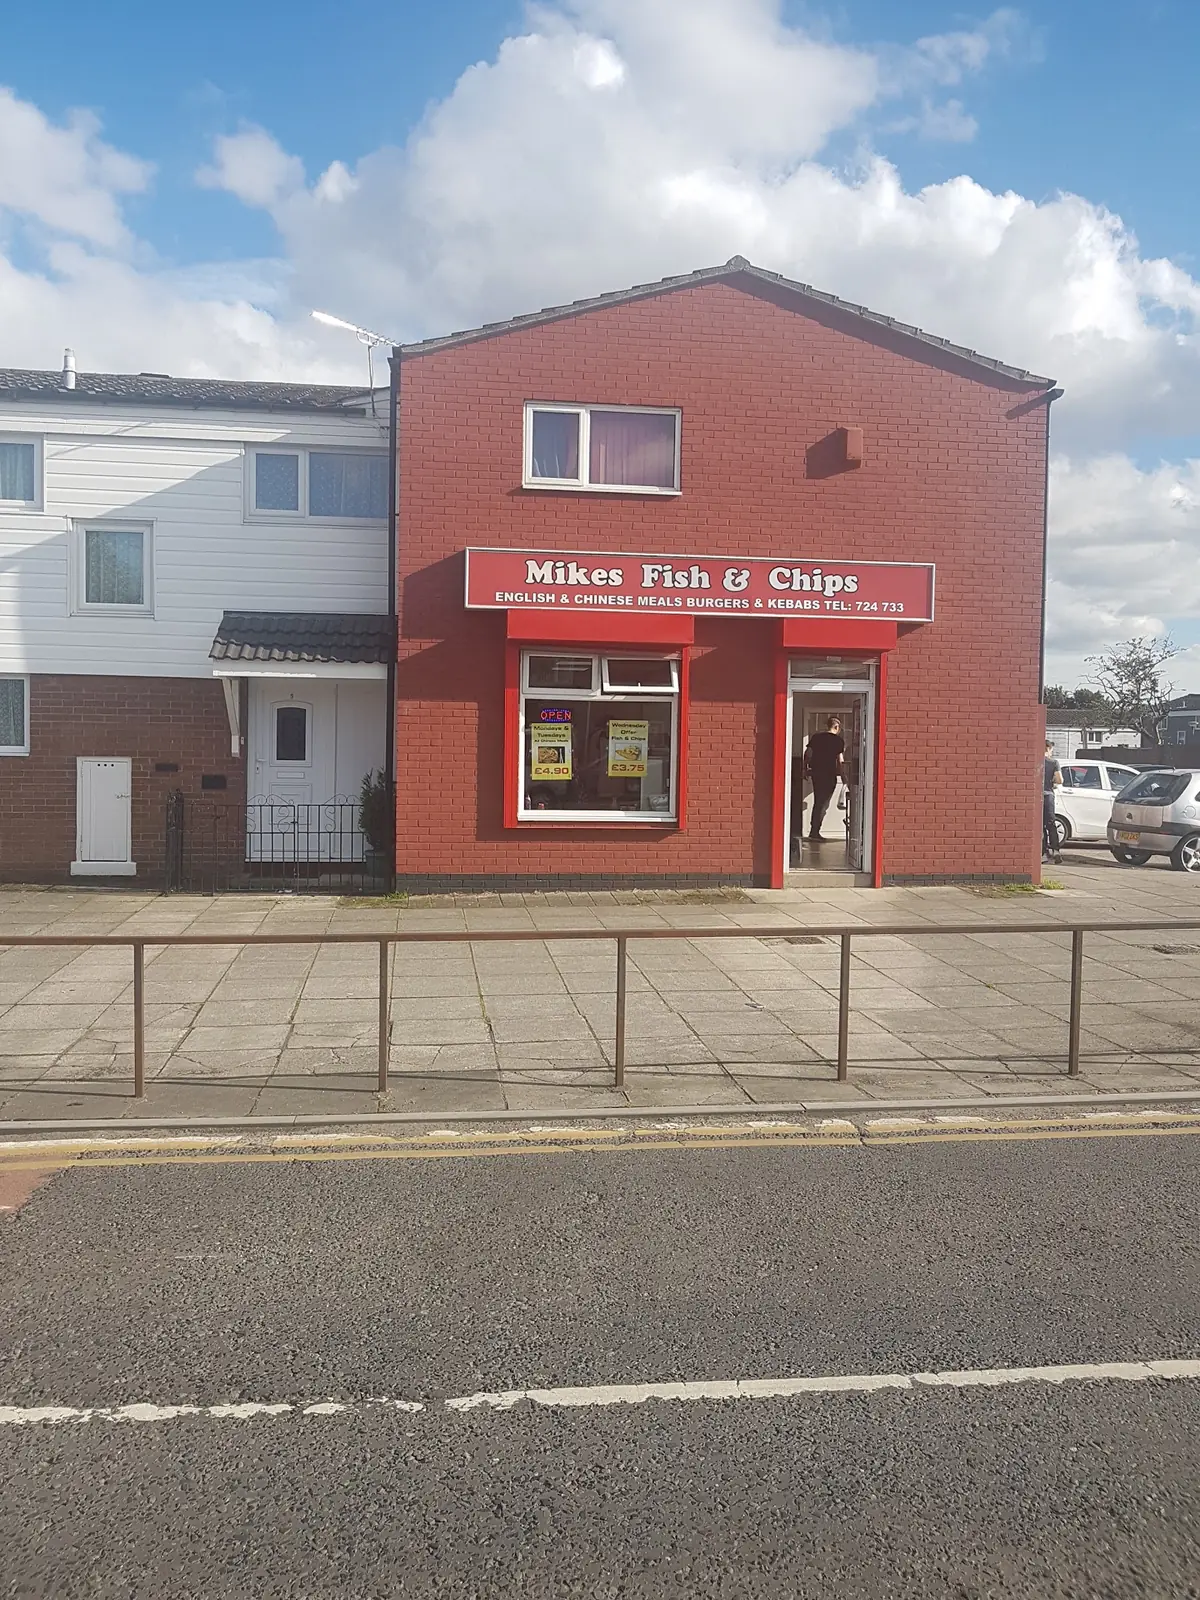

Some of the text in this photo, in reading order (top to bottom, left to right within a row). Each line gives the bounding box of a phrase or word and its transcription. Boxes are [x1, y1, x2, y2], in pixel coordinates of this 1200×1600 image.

[525, 559, 859, 597] Mikes Fish & Chips
[495, 591, 904, 613] ENGLISH & CHINESE MEALS BURGERS & KEBABS TEL: 724 733
[540, 711, 571, 720] OPEN
